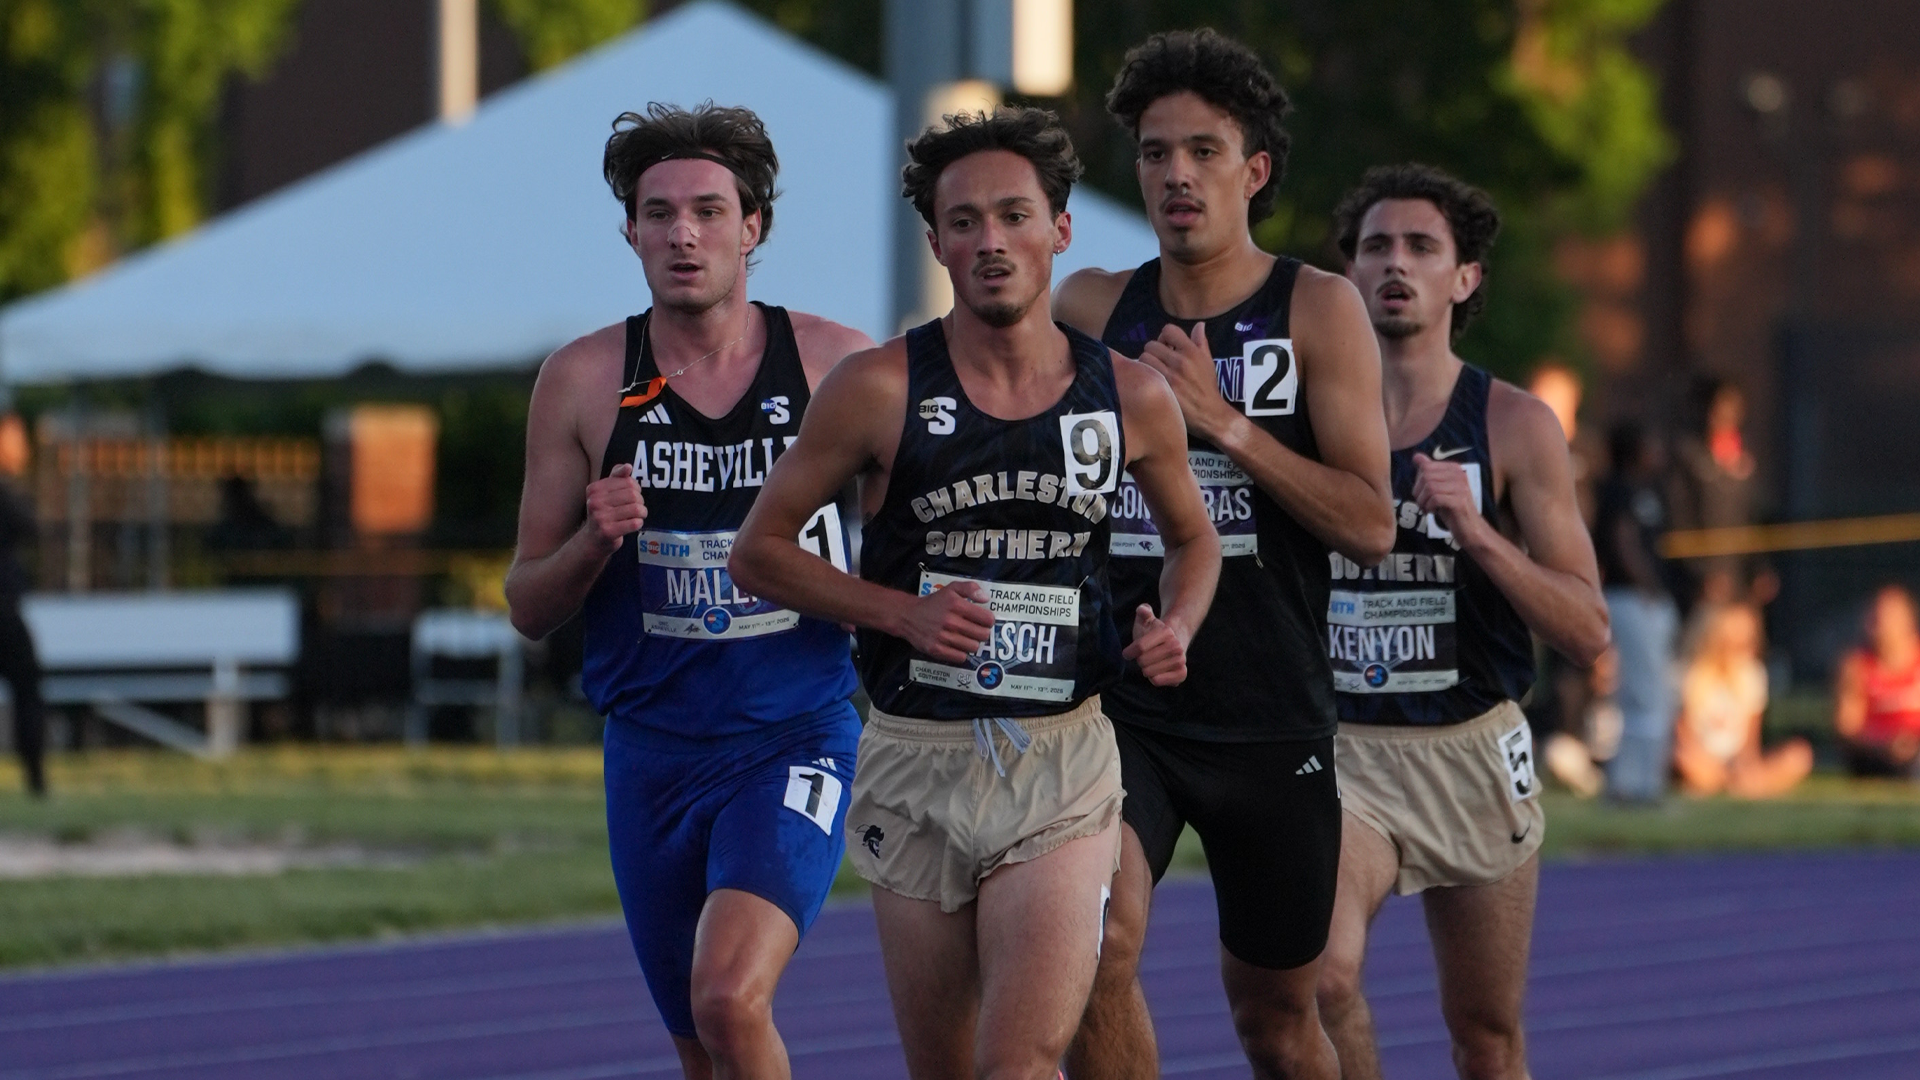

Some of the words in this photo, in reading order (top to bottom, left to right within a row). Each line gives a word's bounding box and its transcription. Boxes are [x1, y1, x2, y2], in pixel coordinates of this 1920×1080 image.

[1250, 344, 1290, 410] 2
[918, 404, 939, 414] BIG
[928, 396, 957, 435] S
[631, 435, 799, 493] ASHEVILL
[1070, 418, 1112, 489] 9
[1195, 457, 1215, 467] AND
[700, 538, 734, 549] TRACK
[806, 514, 832, 565] 1
[925, 529, 1091, 560] SOUTHERN
[989, 602, 1072, 617] CHAMPIONSHIPS
[990, 589, 1021, 601] TRACK
[1023, 592, 1046, 603] AND
[1048, 594, 1074, 605] FIELD
[1362, 600, 1393, 609] TRACK
[1396, 598, 1418, 607] AND
[1420, 596, 1447, 606] FIELD
[1363, 607, 1446, 620] CHAMPIONSHIPS
[969, 622, 1057, 664] ASCH
[1328, 624, 1435, 662] KENYON
[915, 666, 950, 678] CHARLESTON
[918, 672, 948, 683] SOUTHERN
[1505, 730, 1533, 795] 5
[798, 772, 825, 819] 1
